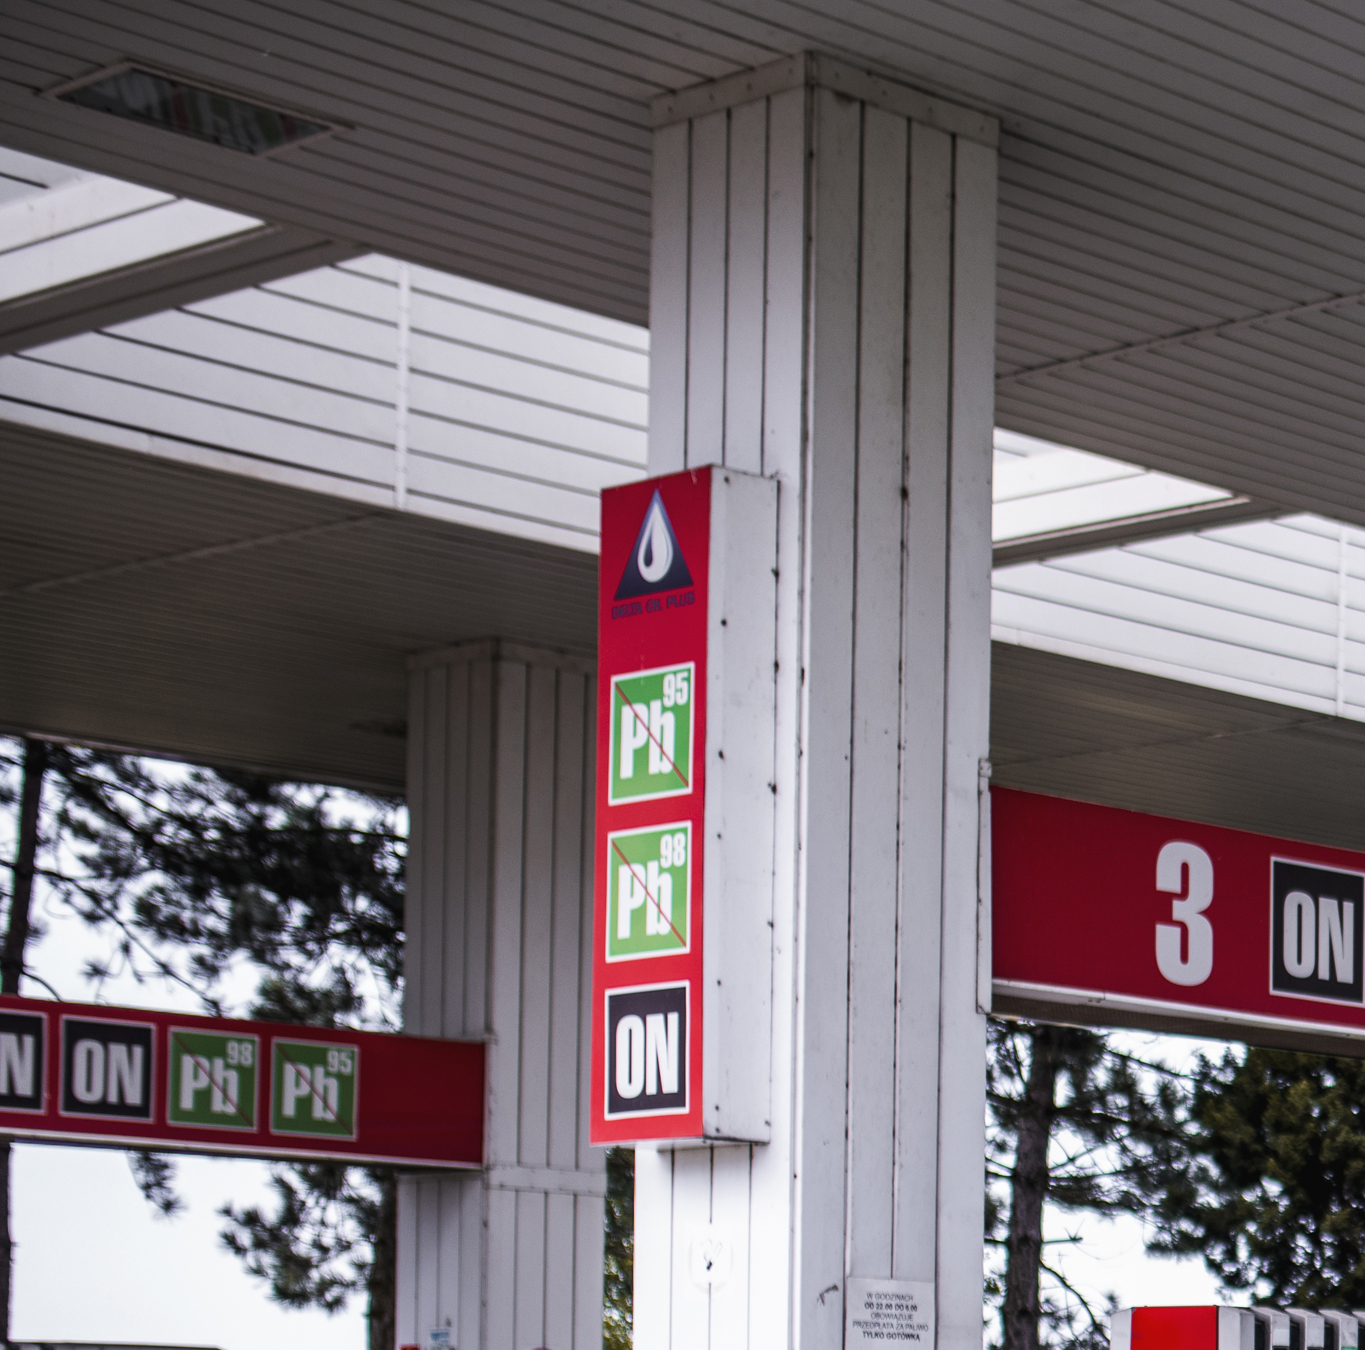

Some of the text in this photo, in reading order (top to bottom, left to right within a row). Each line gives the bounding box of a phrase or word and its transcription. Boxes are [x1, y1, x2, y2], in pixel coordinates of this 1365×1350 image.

[611, 591, 696, 620] DELTA OIL PLUS
[662, 672, 689, 708] 95
[619, 703, 675, 780] Pb
[660, 832, 686, 868] 98
[617, 863, 673, 940] Pb
[1154, 840, 1215, 988] 3
[1282, 890, 1355, 985] ON
[72, 1038, 143, 1106] ON
[179, 1040, 253, 1116] Pb 98
[282, 1049, 353, 1121] Pb 95
[615, 1011, 681, 1100] ON
[862, 1331, 884, 1340] TYLKO
